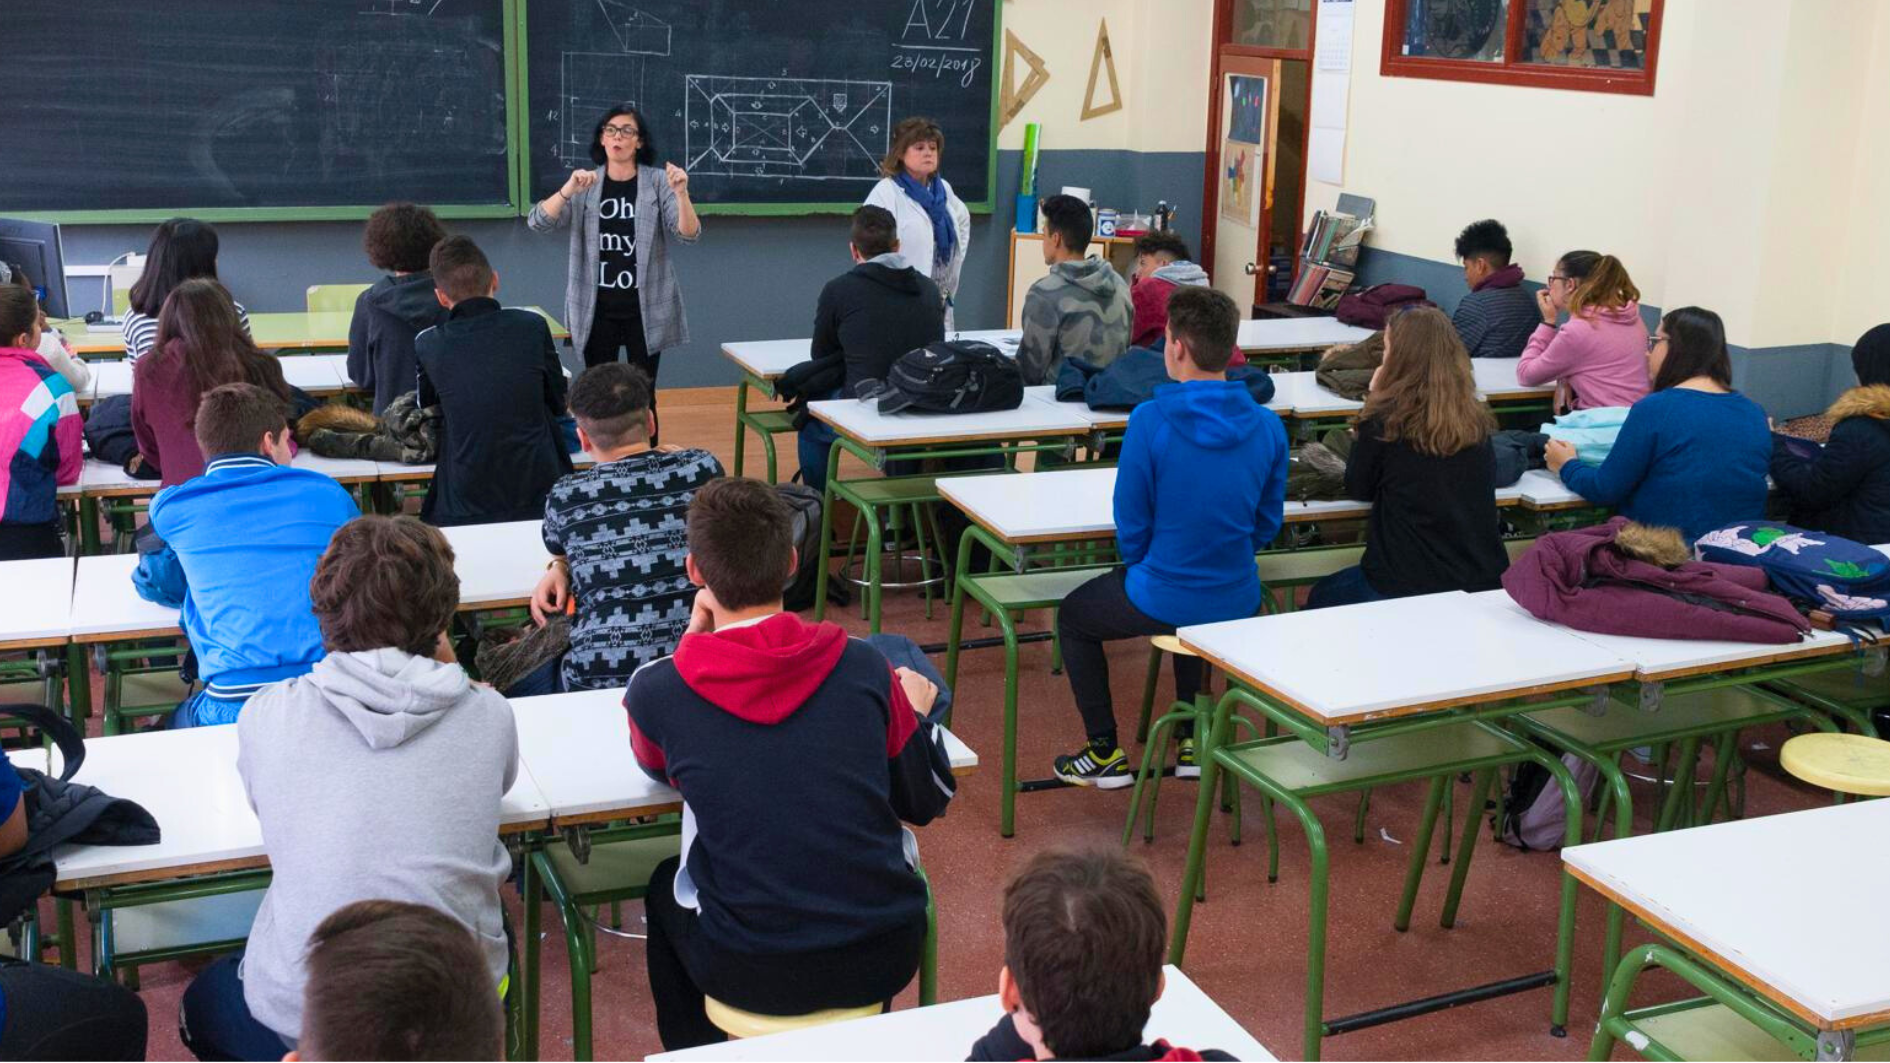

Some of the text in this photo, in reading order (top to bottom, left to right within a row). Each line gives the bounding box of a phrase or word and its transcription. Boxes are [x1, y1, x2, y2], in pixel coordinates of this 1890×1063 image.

[902, 0, 975, 39] A21
[599, 196, 635, 219] Oh
[599, 232, 637, 257] my
